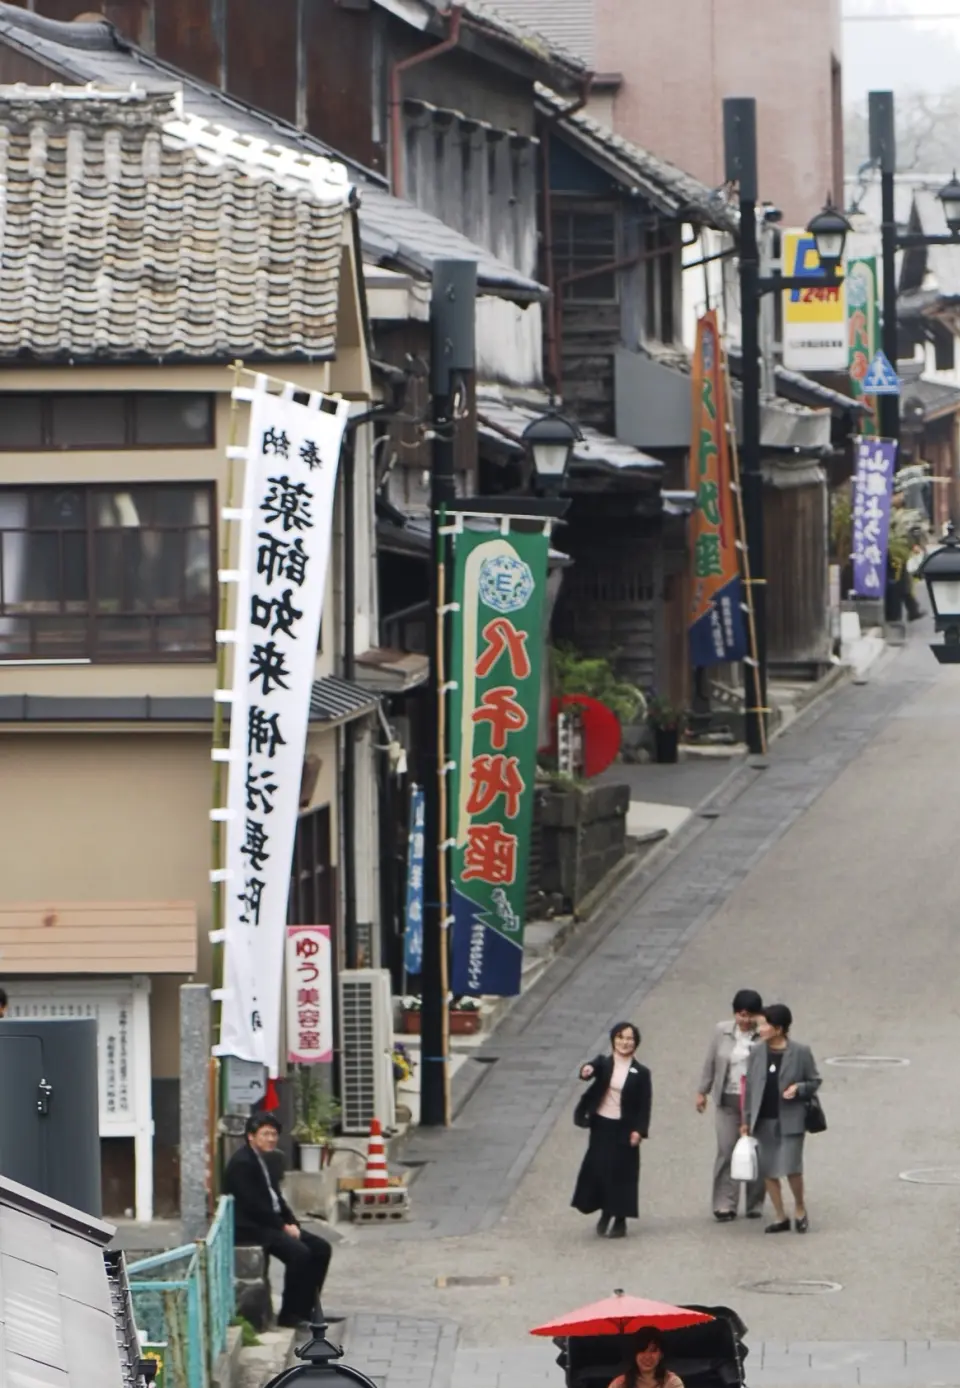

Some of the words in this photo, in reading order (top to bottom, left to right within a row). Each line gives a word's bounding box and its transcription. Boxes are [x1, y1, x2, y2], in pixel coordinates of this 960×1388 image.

[296, 938, 320, 1050] ゆう美容室
